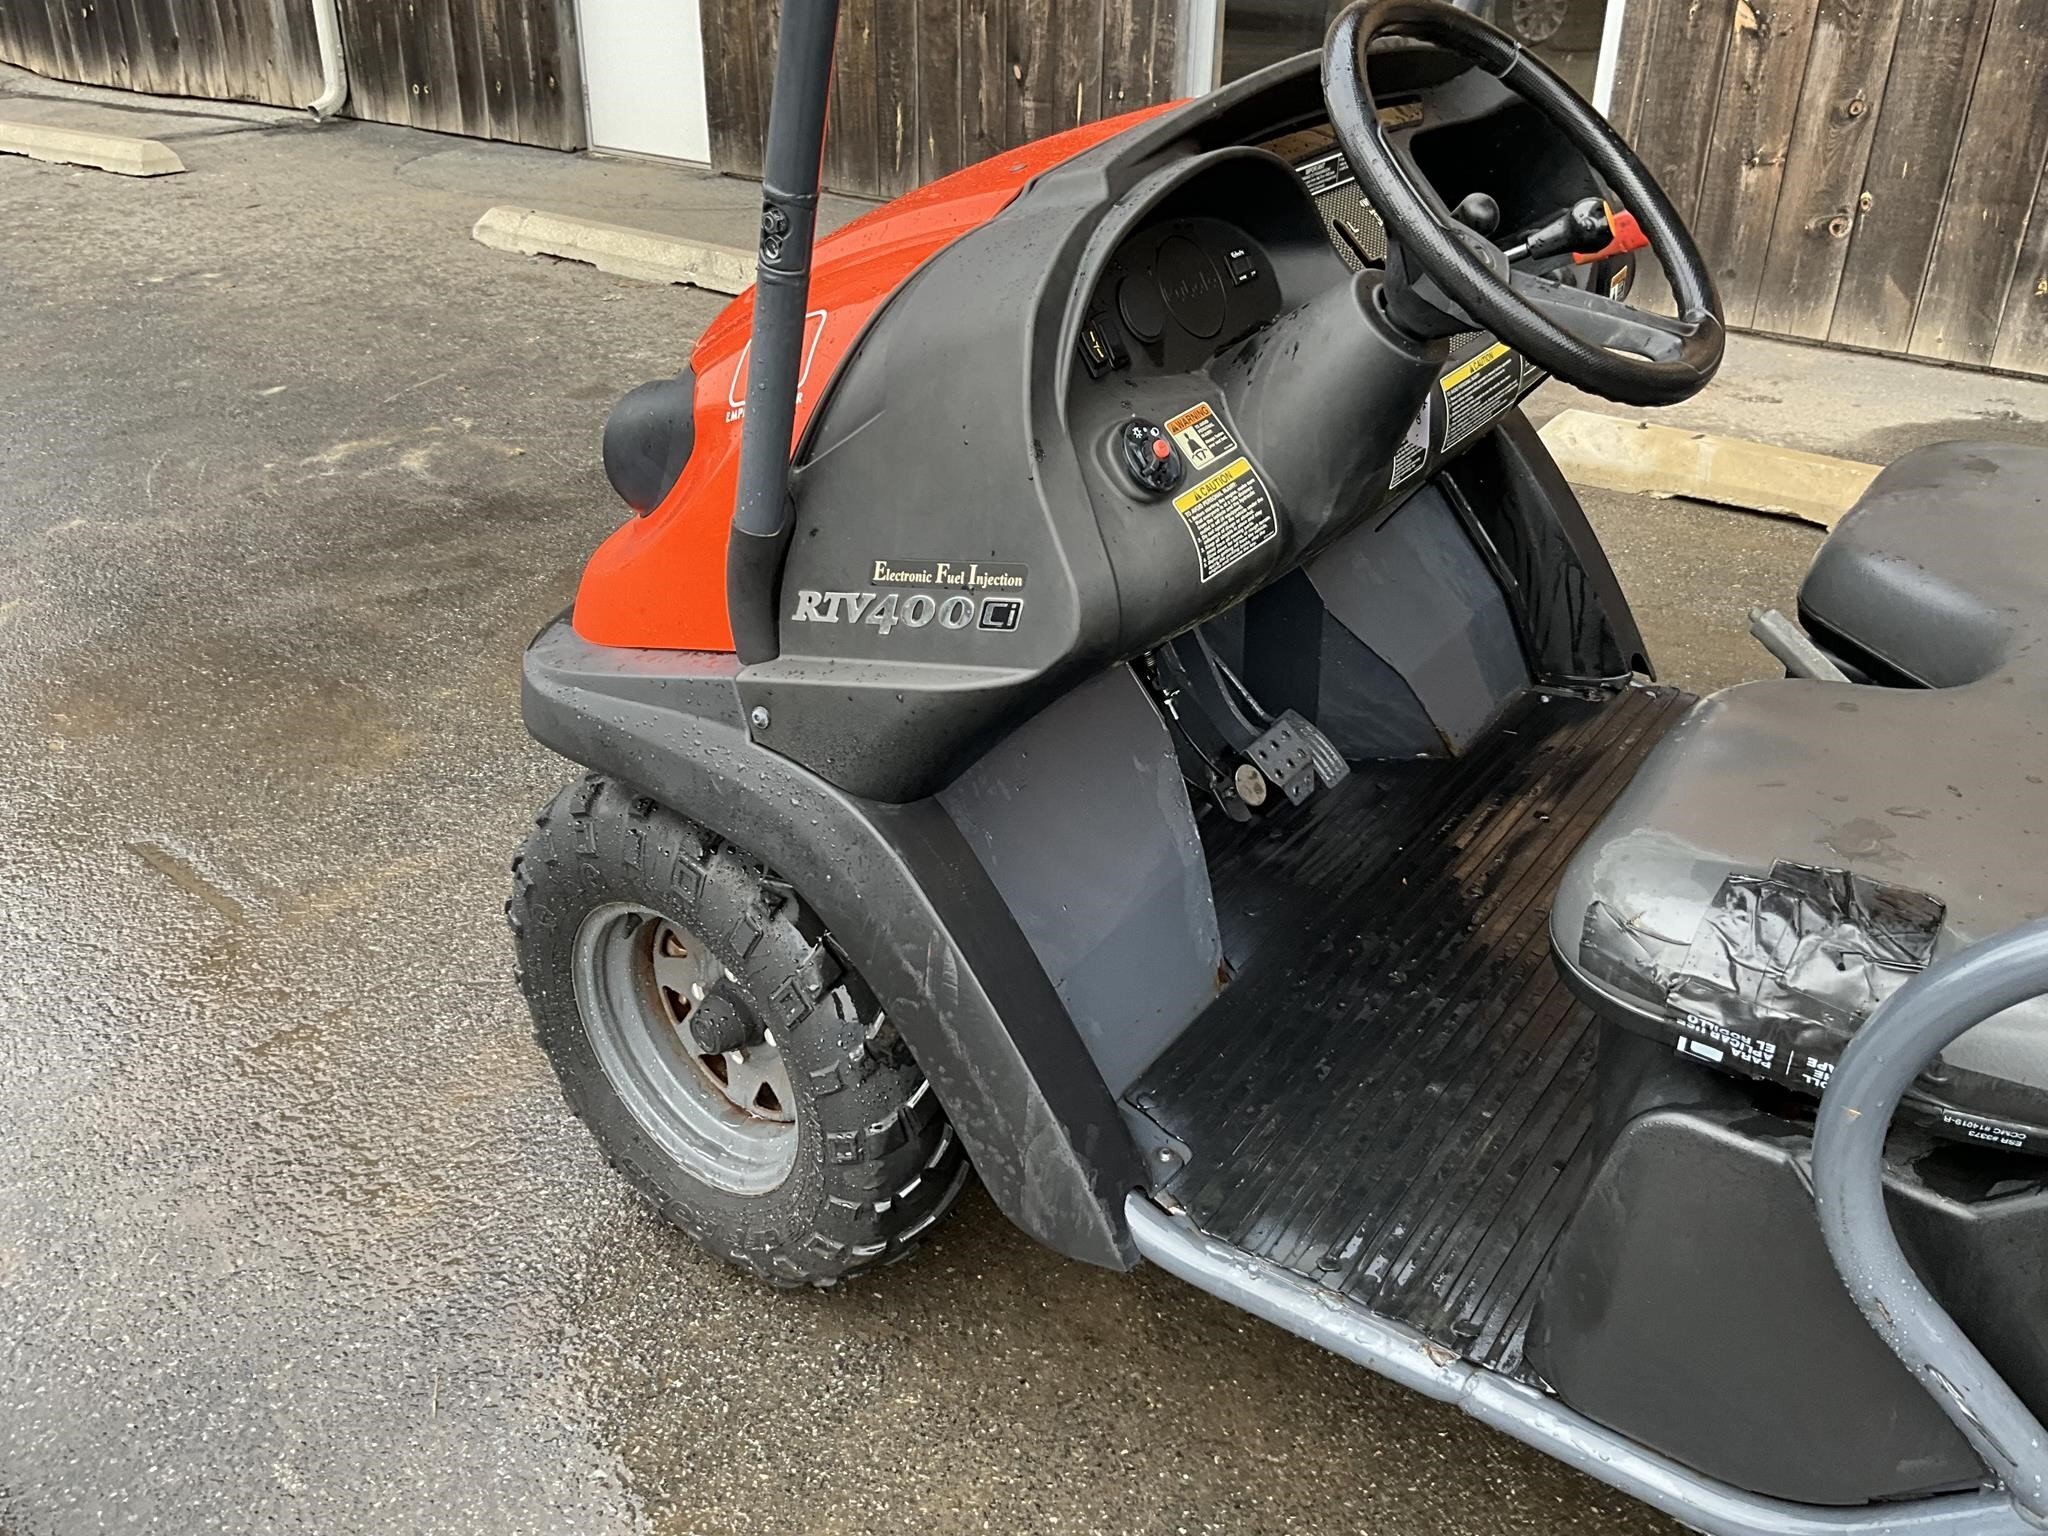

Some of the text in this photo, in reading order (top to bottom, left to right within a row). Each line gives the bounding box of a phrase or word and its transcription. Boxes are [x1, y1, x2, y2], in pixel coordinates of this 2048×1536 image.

[1176, 406, 1209, 429] WARNING
[1200, 471, 1233, 495] CAUTION
[872, 561, 1023, 588] Electronic Fuel Injection
[791, 590, 1017, 635] RTV400 Ci
[1686, 1014, 1776, 1051] EL RODILLO
[1709, 1029, 1775, 1061] APLICAR
[1731, 1047, 1773, 1069] PARA
[1943, 1115, 2027, 1139] CCMC #14019-R
[1968, 1130, 2023, 1147] ESR #3373
